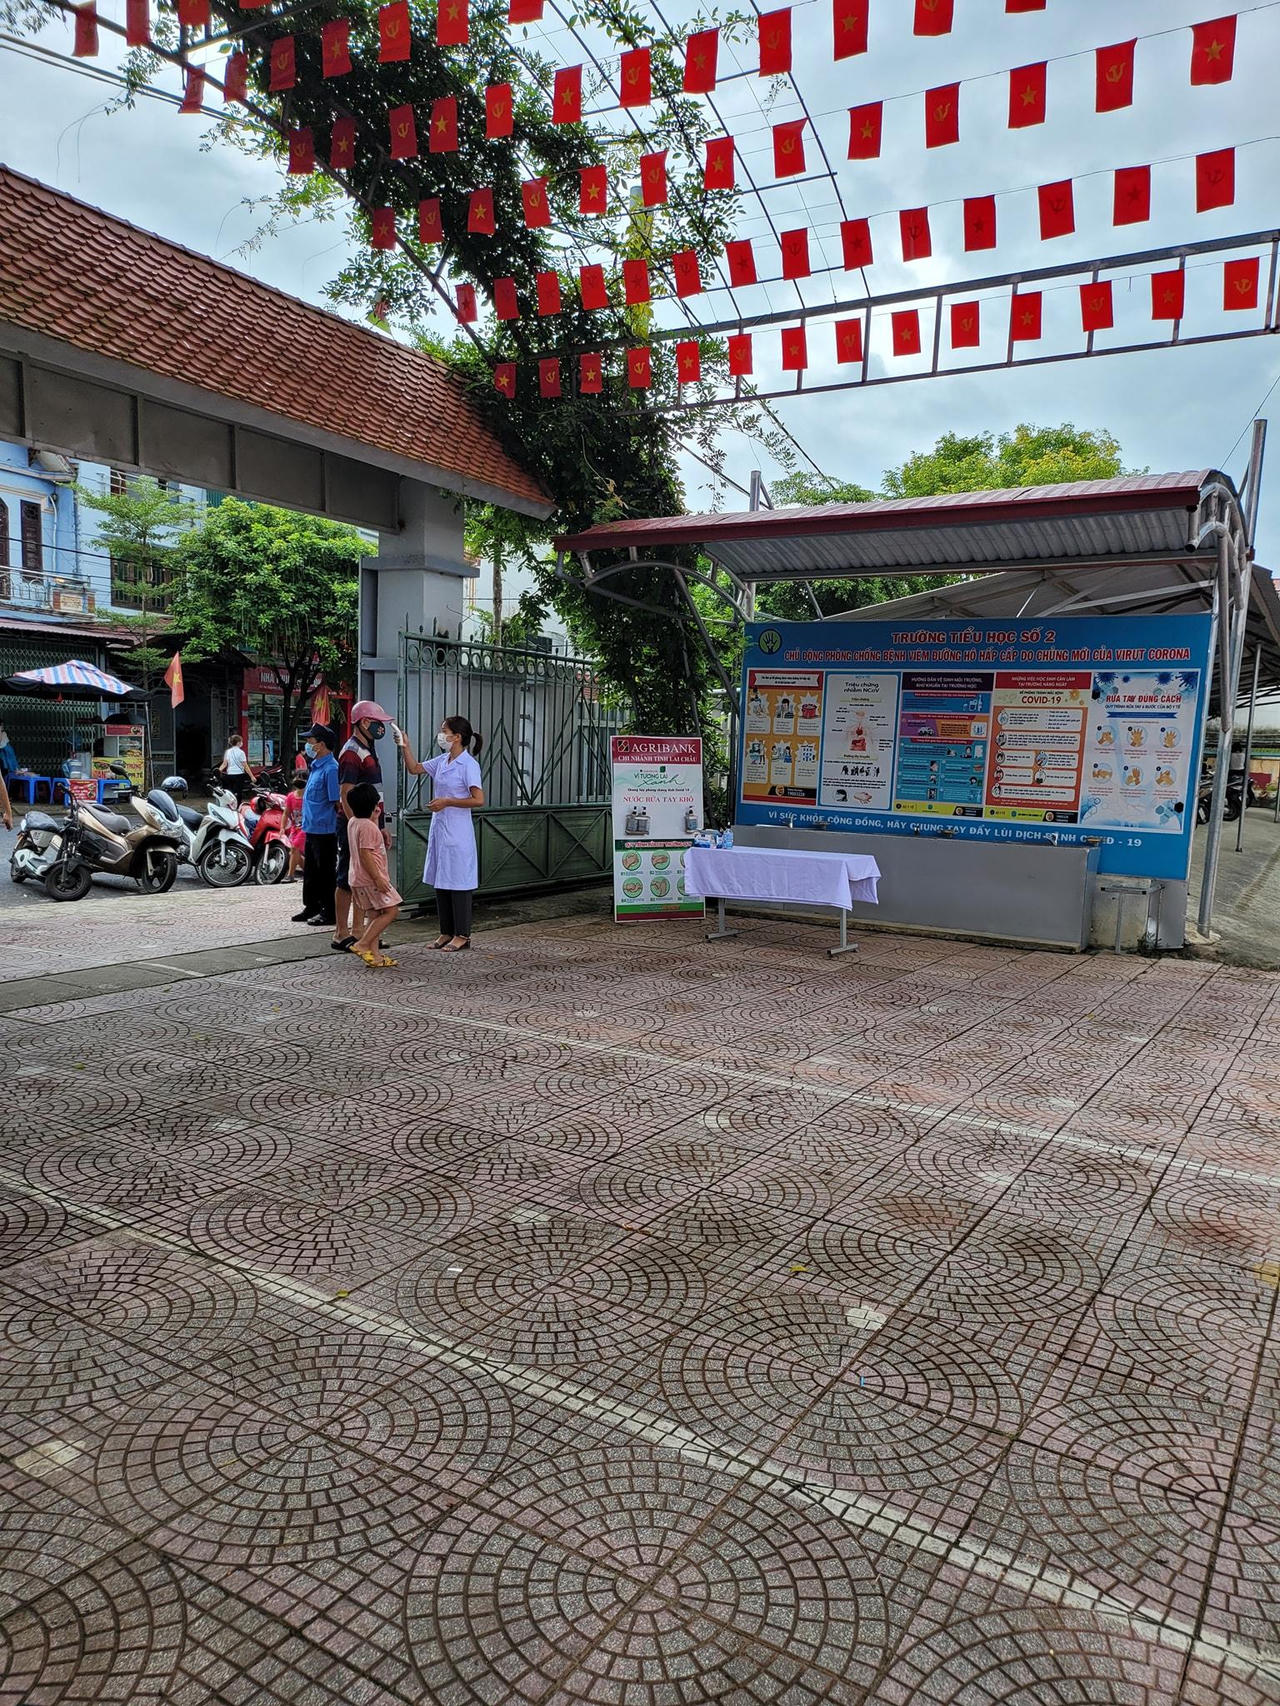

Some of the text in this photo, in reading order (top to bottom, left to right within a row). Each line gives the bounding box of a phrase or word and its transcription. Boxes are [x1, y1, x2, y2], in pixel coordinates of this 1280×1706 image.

[891, 626, 1055, 645] TRƯỜNG TIỂU HỌC SỐ 2
[784, 645, 1190, 664] CHỦ ĐỘNG PHÒNG CHỐNG BỆNH VIÊM ĐƯỜNG HÔ HẤP CẤP DO CHỦNG MỚI CỦA VIRUT CORONA
[1021, 695, 1062, 704] COVID-19
[1123, 695, 1136, 703] TAY
[632, 743, 696, 754] AGRIBANK
[681, 754, 697, 762] CHÂU
[624, 795, 645, 803] NƯỚC
[680, 794, 694, 803] KHÔ
[768, 810, 777, 819] VÌ
[779, 810, 797, 821] SỨC
[827, 815, 853, 827] CỘNG
[855, 815, 884, 828] ĐỒNG,
[887, 818, 907, 829] HÃY
[969, 823, 991, 835] ĐẨY
[1015, 830, 1041, 841] DỊCH
[1045, 831, 1077, 842] BNH
[1127, 837, 1142, 847] 19
